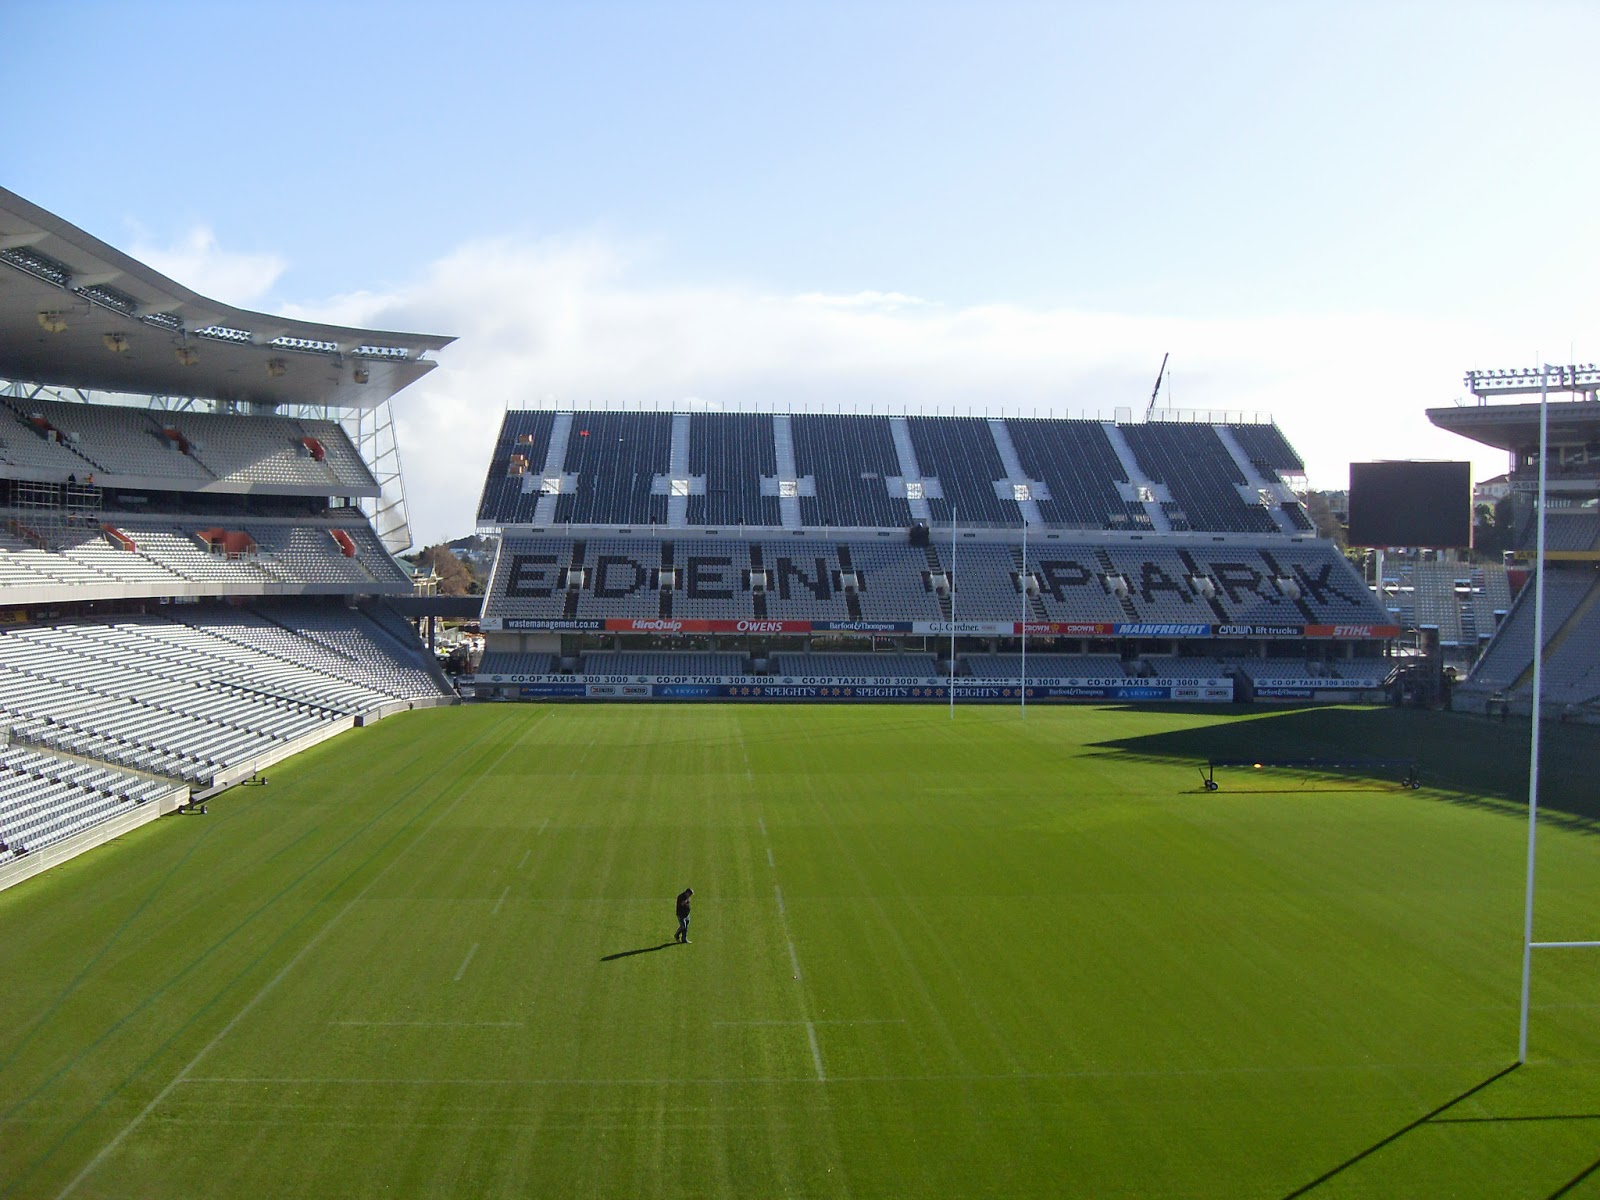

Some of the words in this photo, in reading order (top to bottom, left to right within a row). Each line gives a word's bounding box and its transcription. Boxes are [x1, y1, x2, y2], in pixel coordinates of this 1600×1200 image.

[506, 555, 831, 600] EDEN
[1038, 561, 1361, 605] PARK
[508, 619, 599, 630] wastemanagement.co.nz
[632, 619, 682, 631] HireQuip
[737, 620, 783, 632] OWENS
[929, 622, 944, 632] G.J.
[1118, 624, 1205, 635] MAINFREIGHT
[1255, 626, 1267, 634] lift
[1269, 627, 1298, 635] trucks
[1332, 626, 1371, 636] STIHL
[656, 676, 688, 684] CO-OP
[691, 676, 722, 684] TAXIS
[728, 676, 746, 684] 300
[750, 676, 774, 684] 3000
[764, 686, 816, 696] SPEIGHT'S
[856, 687, 908, 697] SPEIGHT'S
[947, 687, 999, 697] SPEIGHT'S
